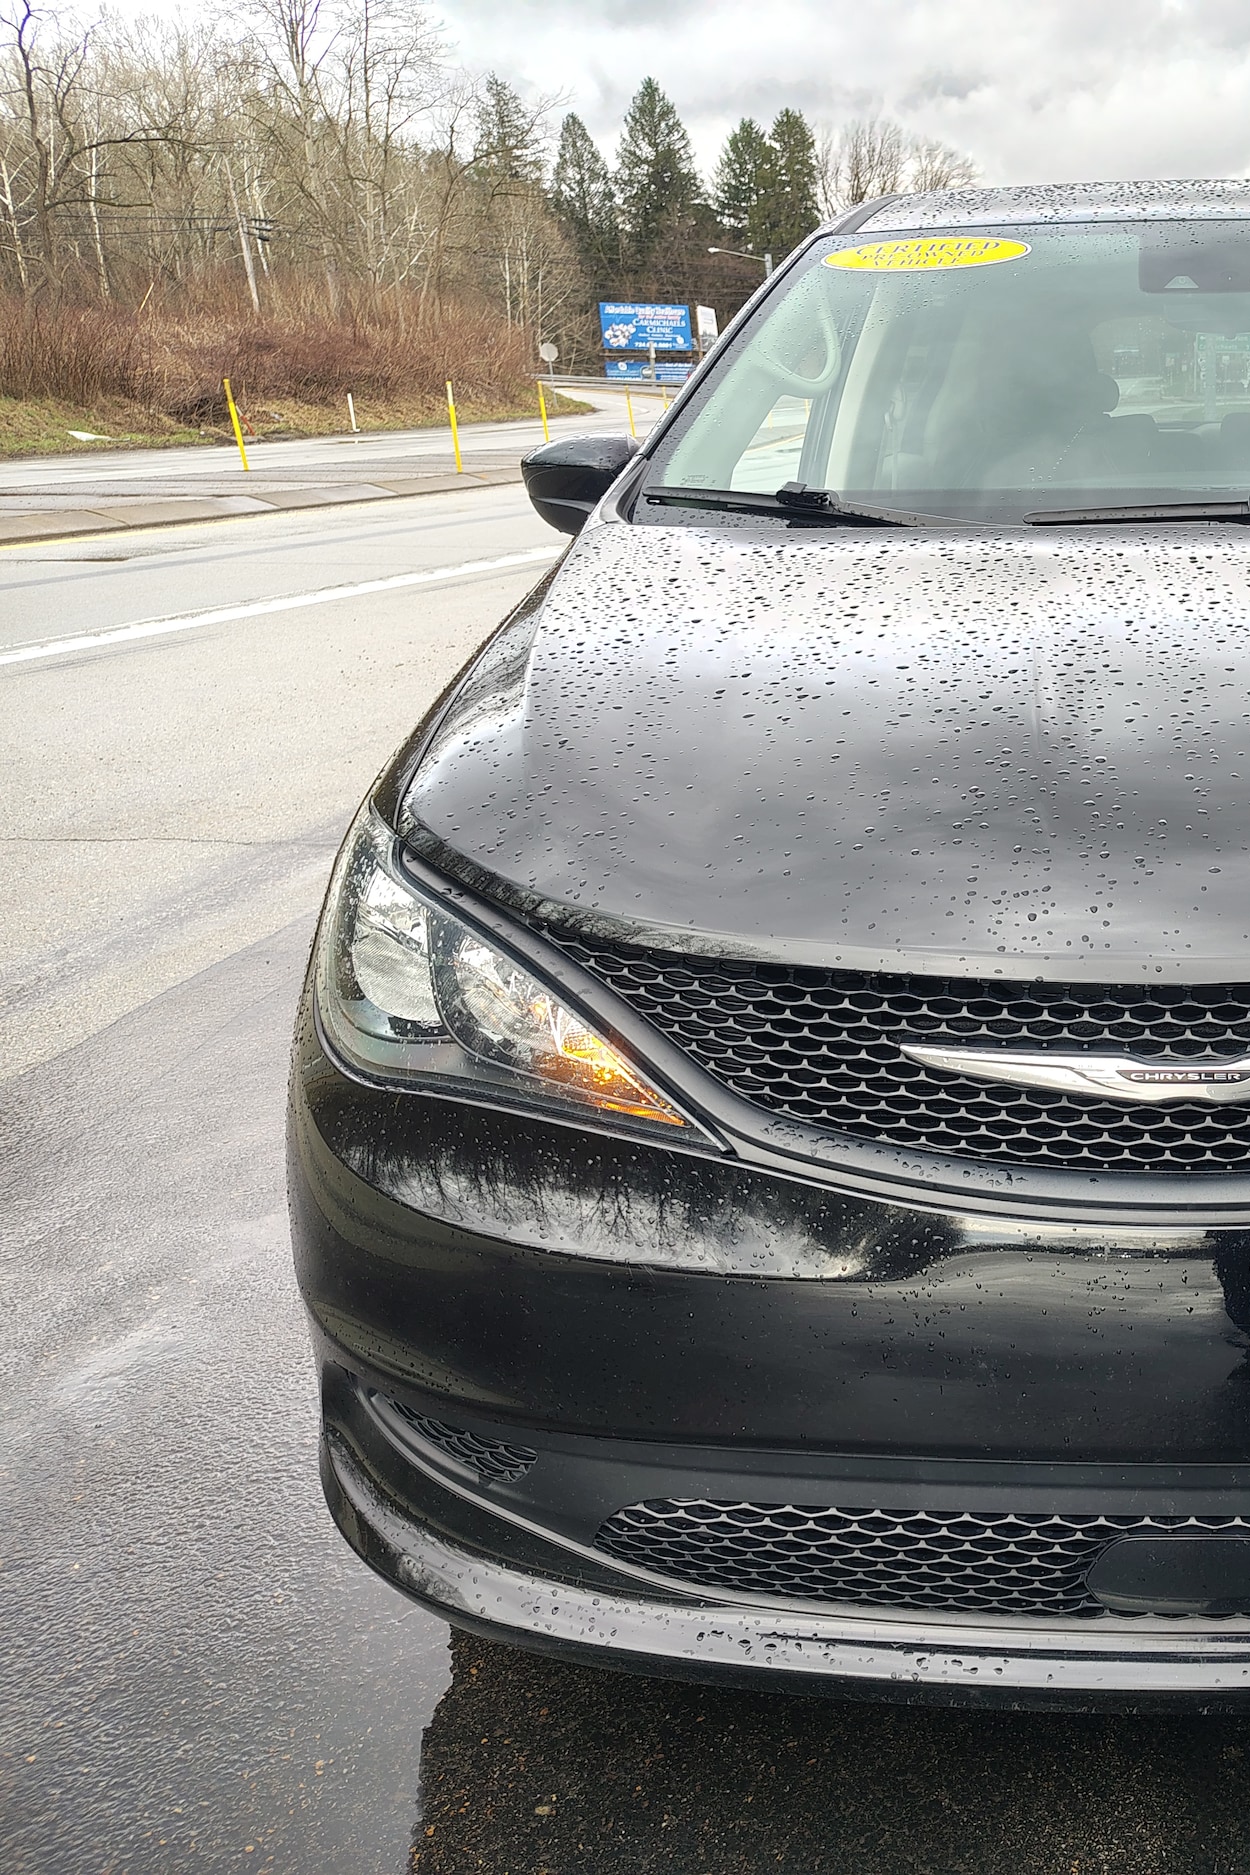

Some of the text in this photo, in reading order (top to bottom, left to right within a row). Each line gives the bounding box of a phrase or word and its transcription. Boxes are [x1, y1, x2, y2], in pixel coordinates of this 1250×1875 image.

[856, 242, 1000, 255] CERTIFIED
[862, 250, 985, 261] PRE-OWNED
[874, 257, 961, 267] VEHICLE
[1130, 1072, 1241, 1081] CHRYSLER
